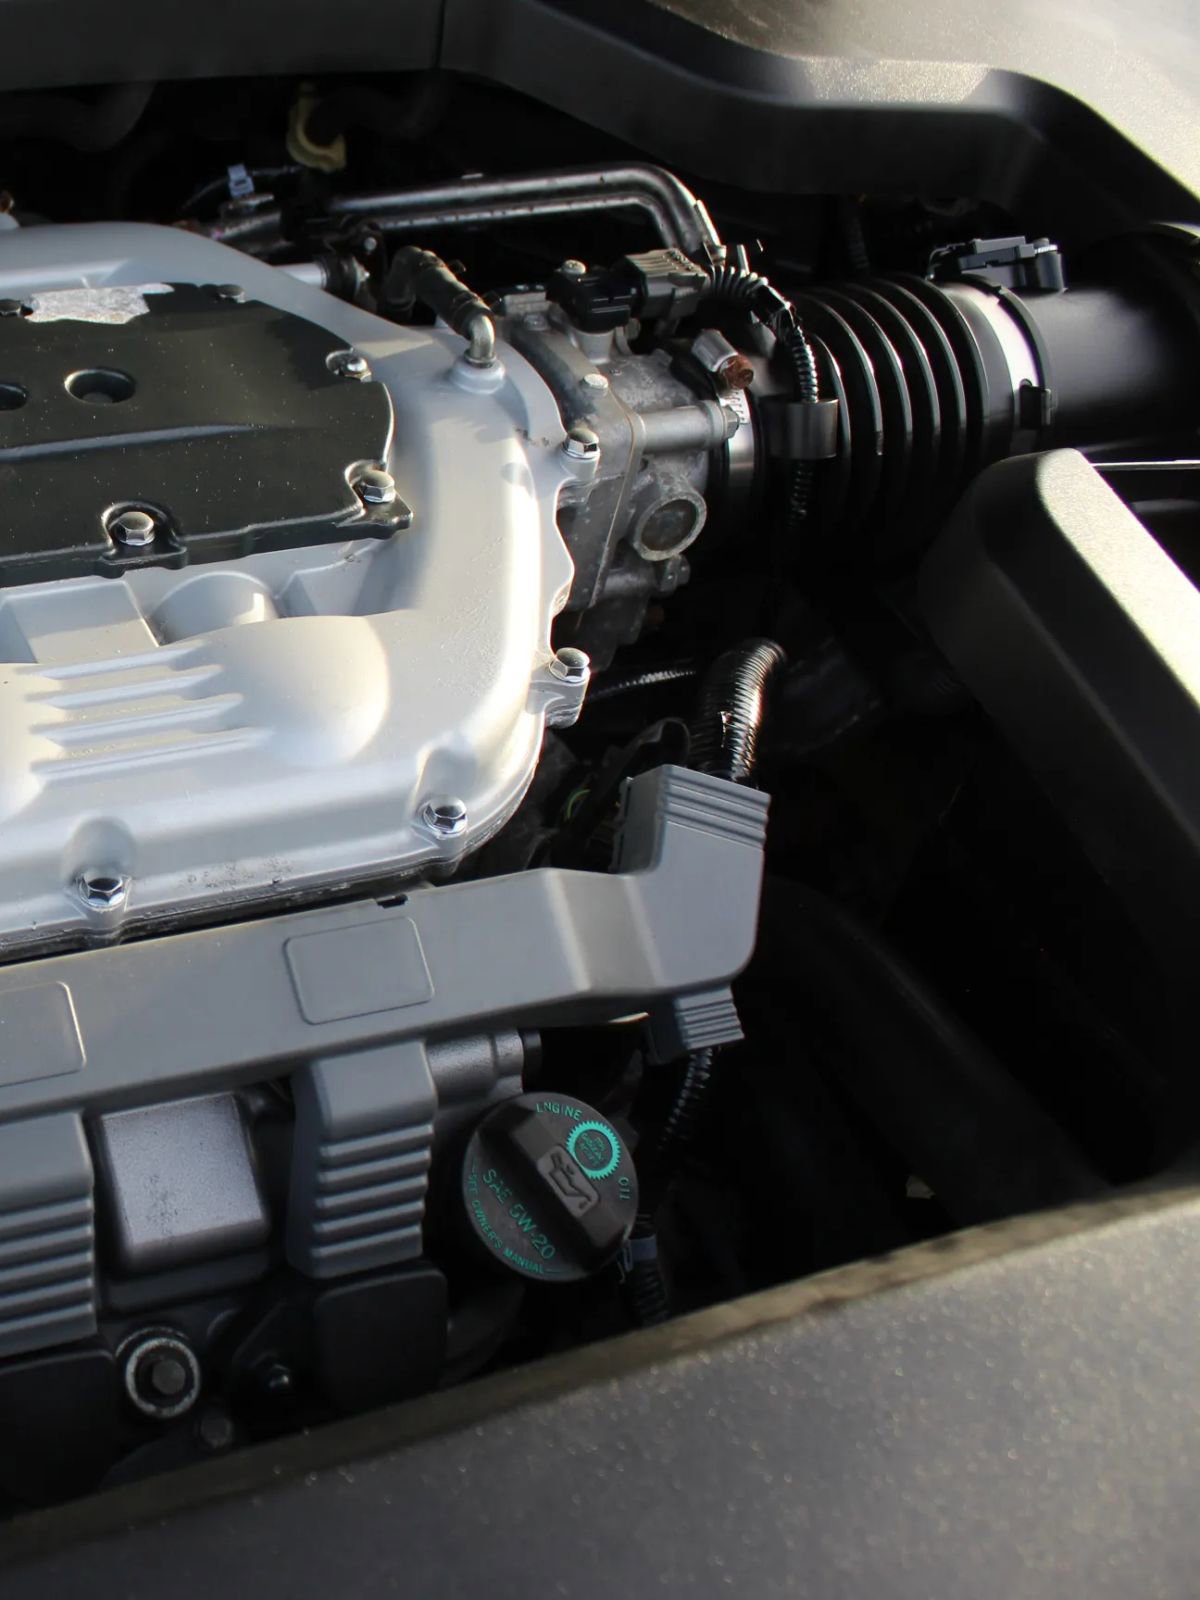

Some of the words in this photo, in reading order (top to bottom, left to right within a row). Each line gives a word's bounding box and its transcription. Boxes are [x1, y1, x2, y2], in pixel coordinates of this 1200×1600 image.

[536, 1101, 583, 1121] ENGINE
[618, 1176, 632, 1200] OIL
[482, 1168, 512, 1204] SAE
[508, 1203, 556, 1259] 5W-20
[503, 1249, 545, 1274] MANUAL
